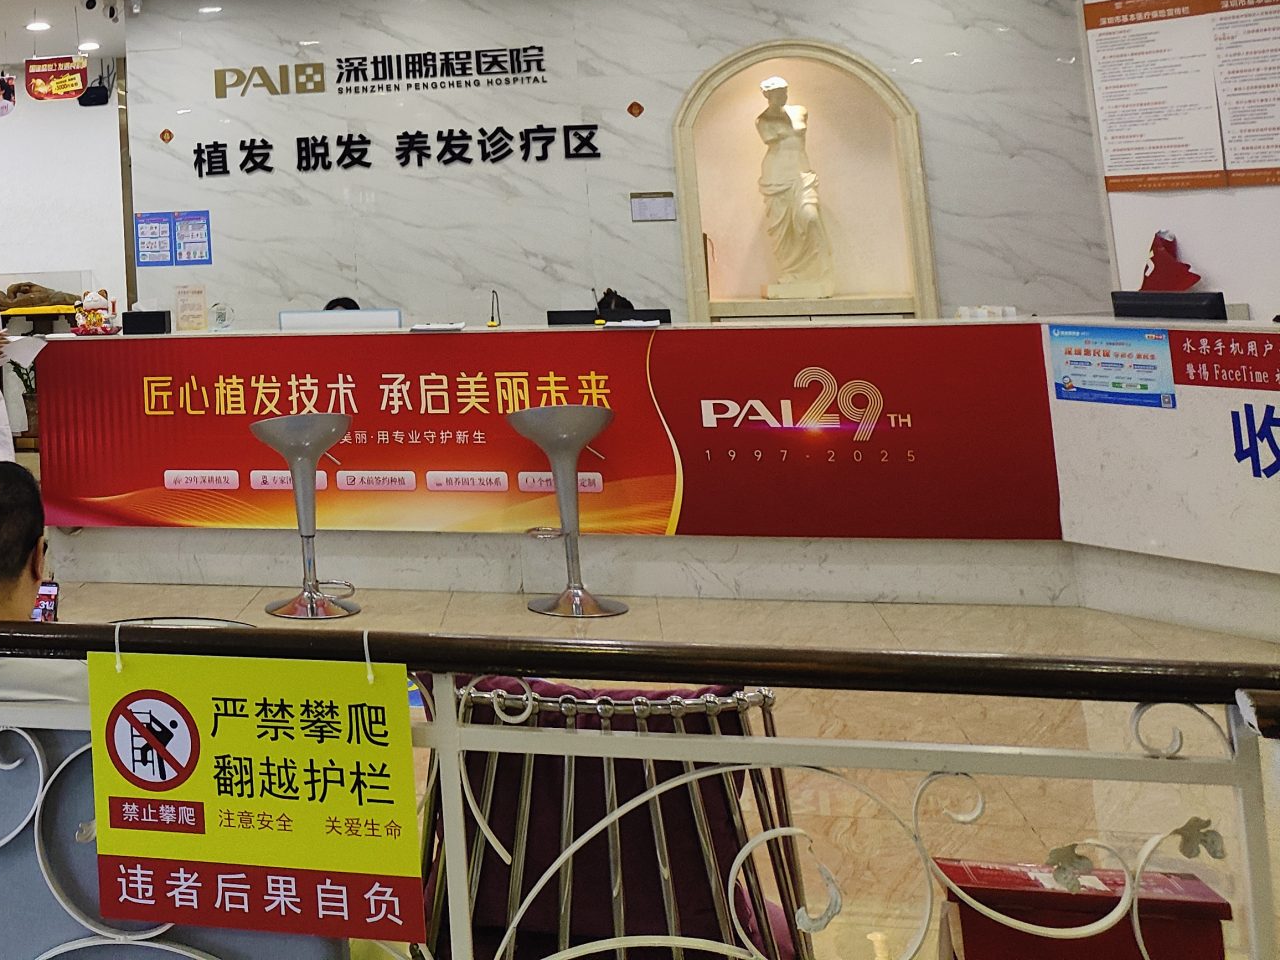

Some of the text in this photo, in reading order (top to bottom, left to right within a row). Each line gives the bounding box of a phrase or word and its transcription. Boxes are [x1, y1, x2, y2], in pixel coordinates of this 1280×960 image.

[214, 64, 290, 99] PAI
[336, 45, 546, 84] 深圳鹏程医院
[337, 75, 548, 95] SHENZHEN PENGCHENG HOSPITAL
[193, 124, 601, 178] 植发 脱发 养发诊疗区
[1182, 338, 1278, 358] 水果手机用户
[1214, 363, 1269, 384] FaceTime
[143, 371, 612, 416] 匠心植发技术 承启美丽未来
[701, 399, 793, 428] PAI
[210, 696, 390, 747] 严禁攀爬
[213, 753, 395, 806] 翻越护栏
[122, 801, 196, 826] 禁止攀爬
[217, 808, 403, 840] 注意安全 关爱生命
[116, 863, 404, 926] 违者后果自负
